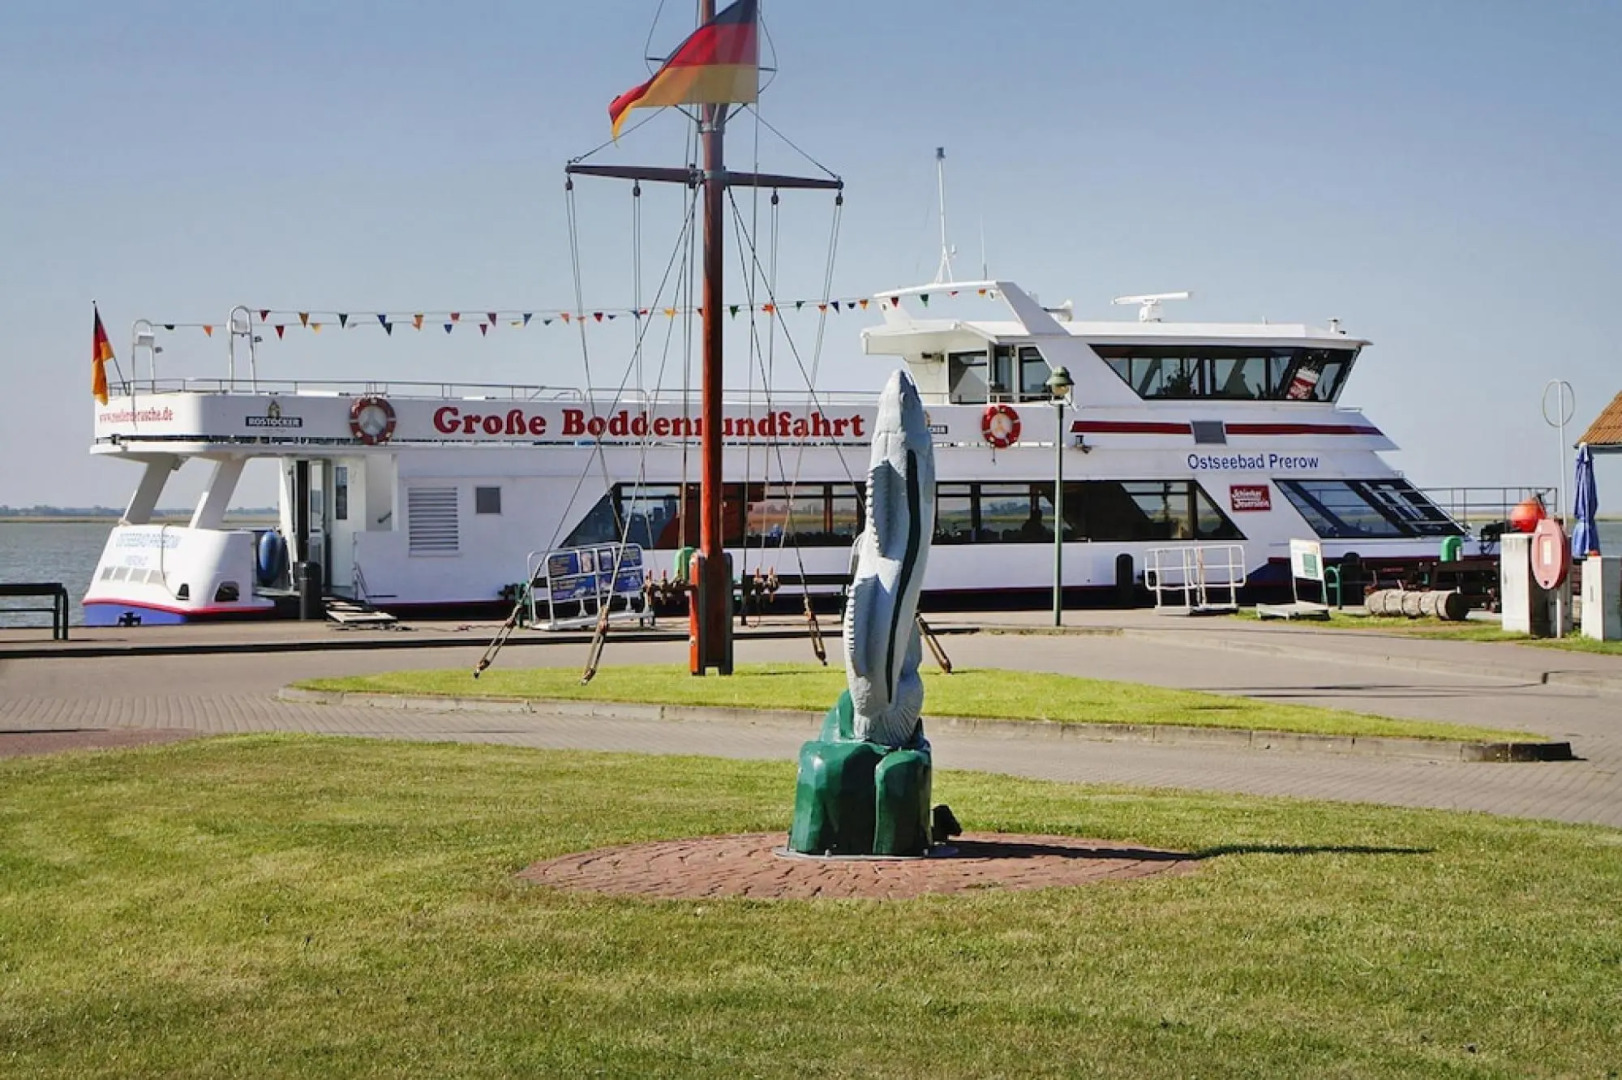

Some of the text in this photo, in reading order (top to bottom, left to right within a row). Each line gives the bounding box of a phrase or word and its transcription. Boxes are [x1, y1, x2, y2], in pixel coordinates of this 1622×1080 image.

[248, 417, 300, 427] ROSTOCKER
[433, 406, 547, 436] Große
[1187, 453, 1319, 470] Ostseebad Prerow
